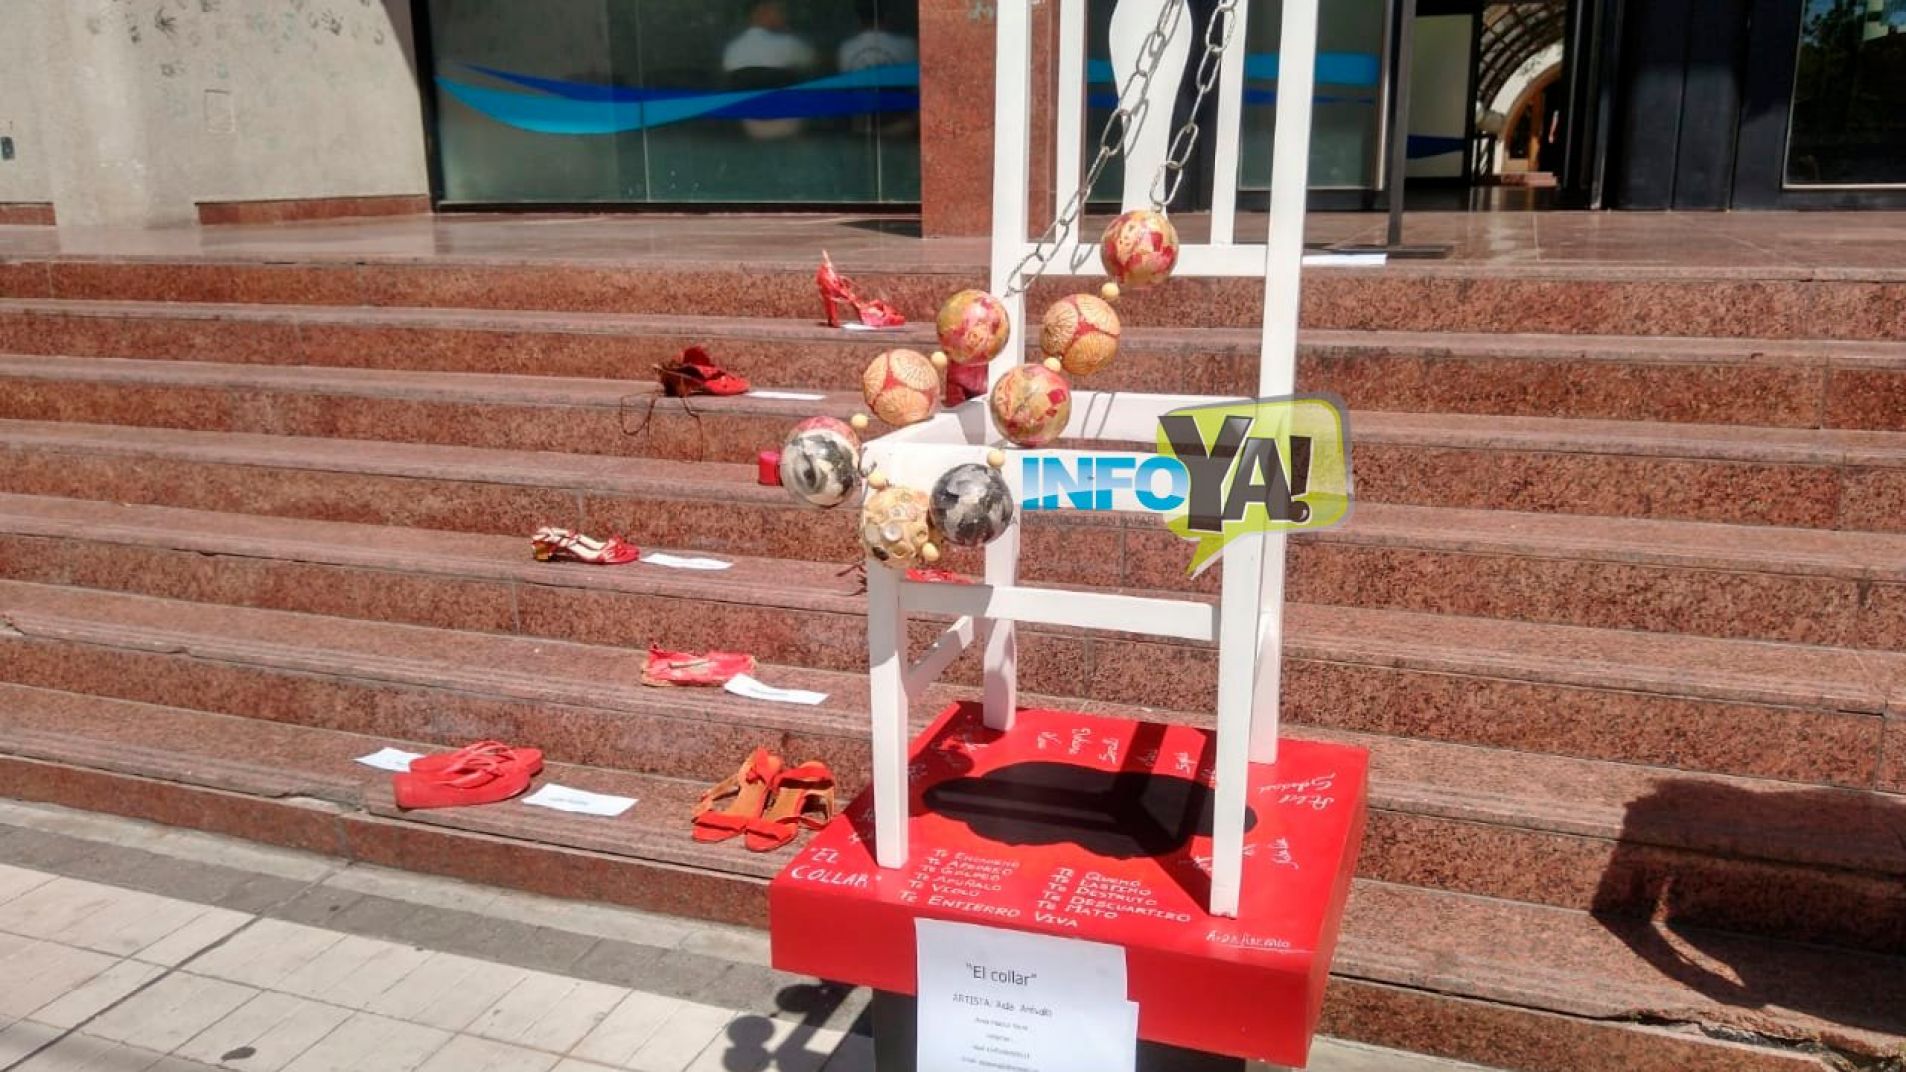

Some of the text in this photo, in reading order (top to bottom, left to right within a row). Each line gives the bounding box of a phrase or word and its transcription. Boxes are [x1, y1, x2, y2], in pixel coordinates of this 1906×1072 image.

[928, 895, 1021, 918] ENTIERRO
[1034, 911, 1079, 928] VIVA
[1064, 904, 1118, 919] MATO
